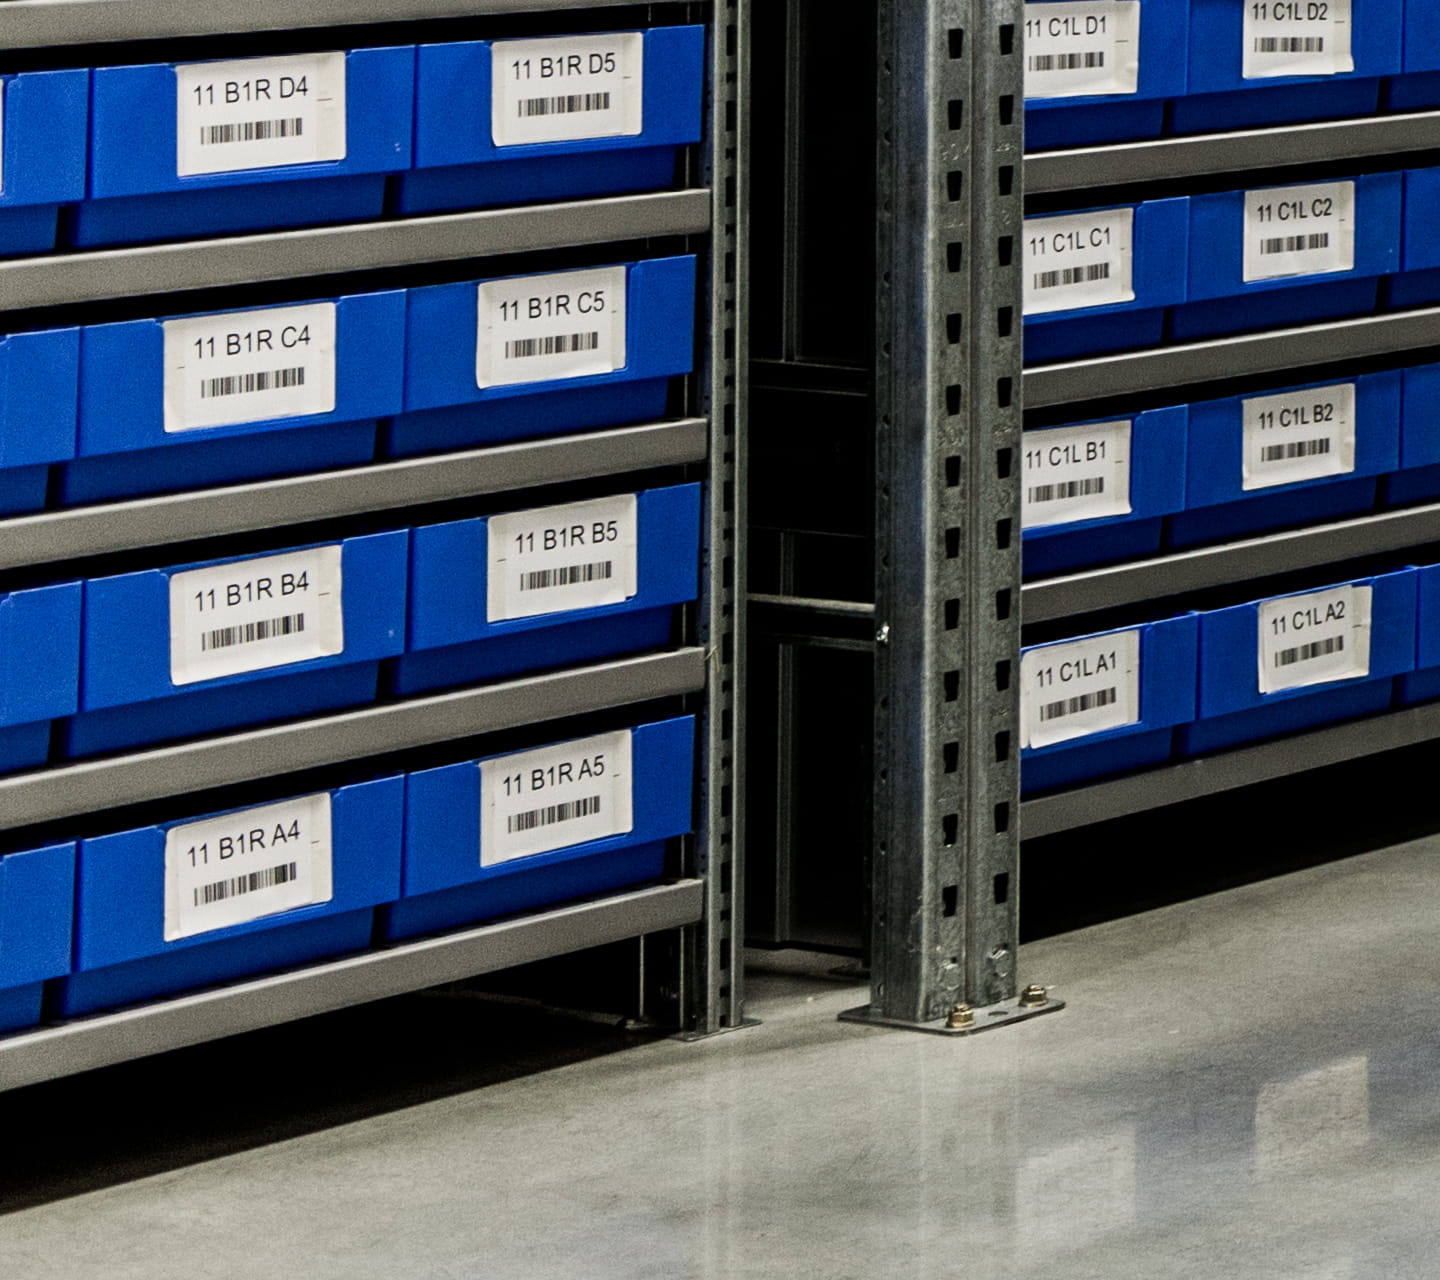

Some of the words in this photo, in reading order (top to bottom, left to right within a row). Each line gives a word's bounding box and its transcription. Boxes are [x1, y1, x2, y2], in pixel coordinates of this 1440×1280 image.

[1252, 2, 1267, 21] 11
[1273, 2, 1303, 22] C1L
[1307, 2, 1328, 22] D2
[513, 59, 530, 80] 11
[540, 54, 582, 79] B1R
[589, 52, 616, 75] D5
[1030, 237, 1045, 256] 11
[1052, 231, 1086, 254] C1L
[1089, 227, 1110, 248] C1
[194, 337, 214, 360] 11
[226, 329, 273, 357] B1R
[281, 325, 311, 349] C4
[1258, 411, 1274, 430] 11
[1279, 406, 1310, 429] C1L
[1313, 402, 1334, 424] B2
[516, 532, 534, 554] 11
[543, 524, 585, 552] B1R
[592, 520, 618, 545] B5
[1037, 667, 1052, 688] 11
[1059, 658, 1093, 683] C1L
[1095, 651, 1116, 675] A1
[188, 843, 208, 868] 11
[219, 828, 266, 861] B1R
[271, 819, 300, 847] A4
